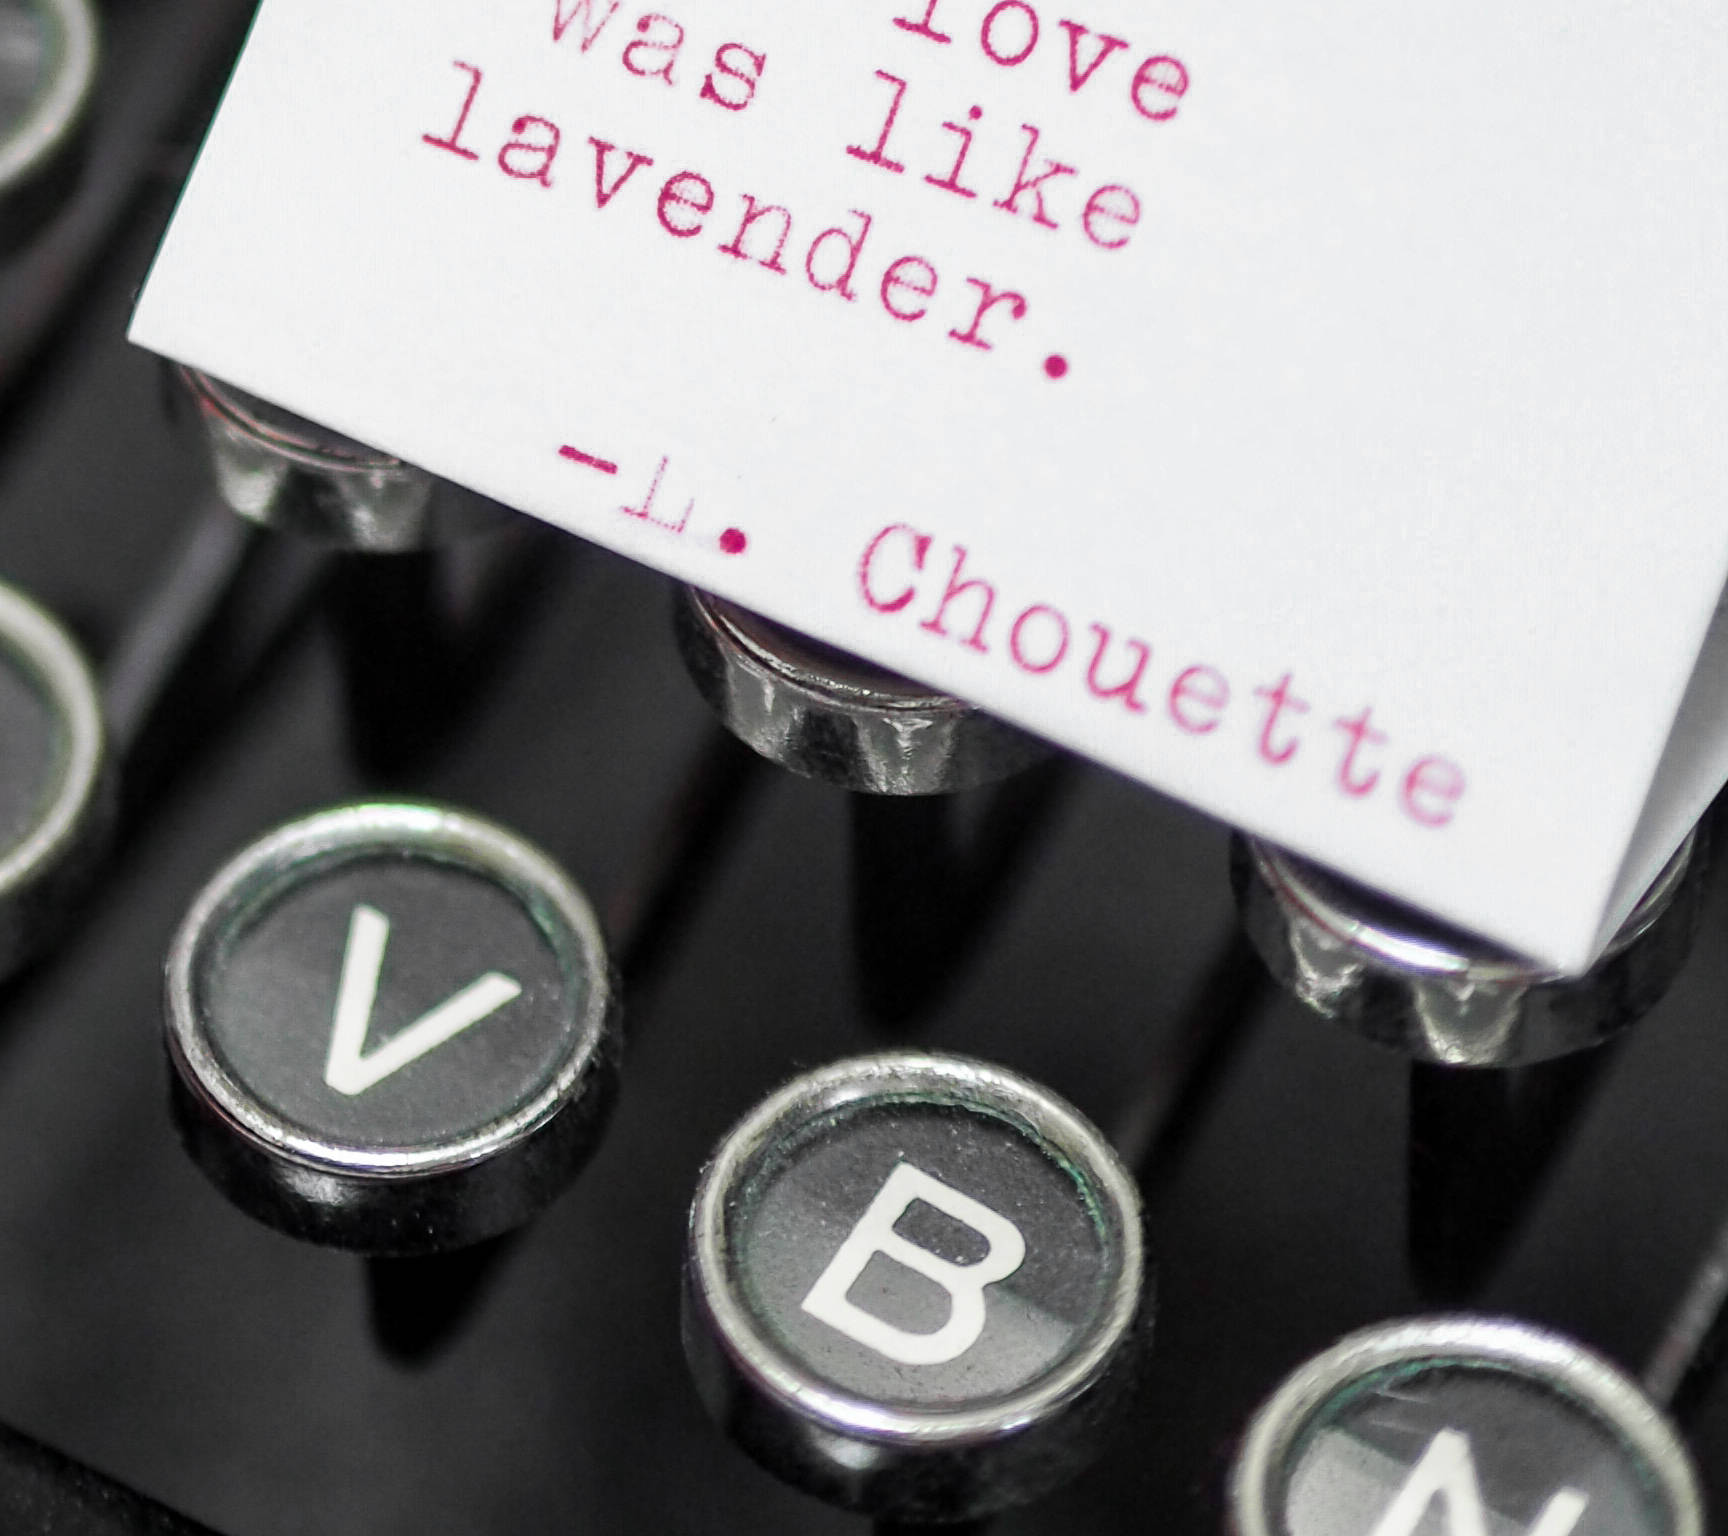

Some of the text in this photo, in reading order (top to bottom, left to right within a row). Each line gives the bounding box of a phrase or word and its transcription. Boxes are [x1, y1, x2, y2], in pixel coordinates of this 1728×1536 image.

[421, 60, 1070, 382] lavender.
[845, 68, 1144, 251] like
[858, 523, 1469, 830] Chouette
[323, 904, 523, 1097] V
[801, 1162, 1026, 1366] B
